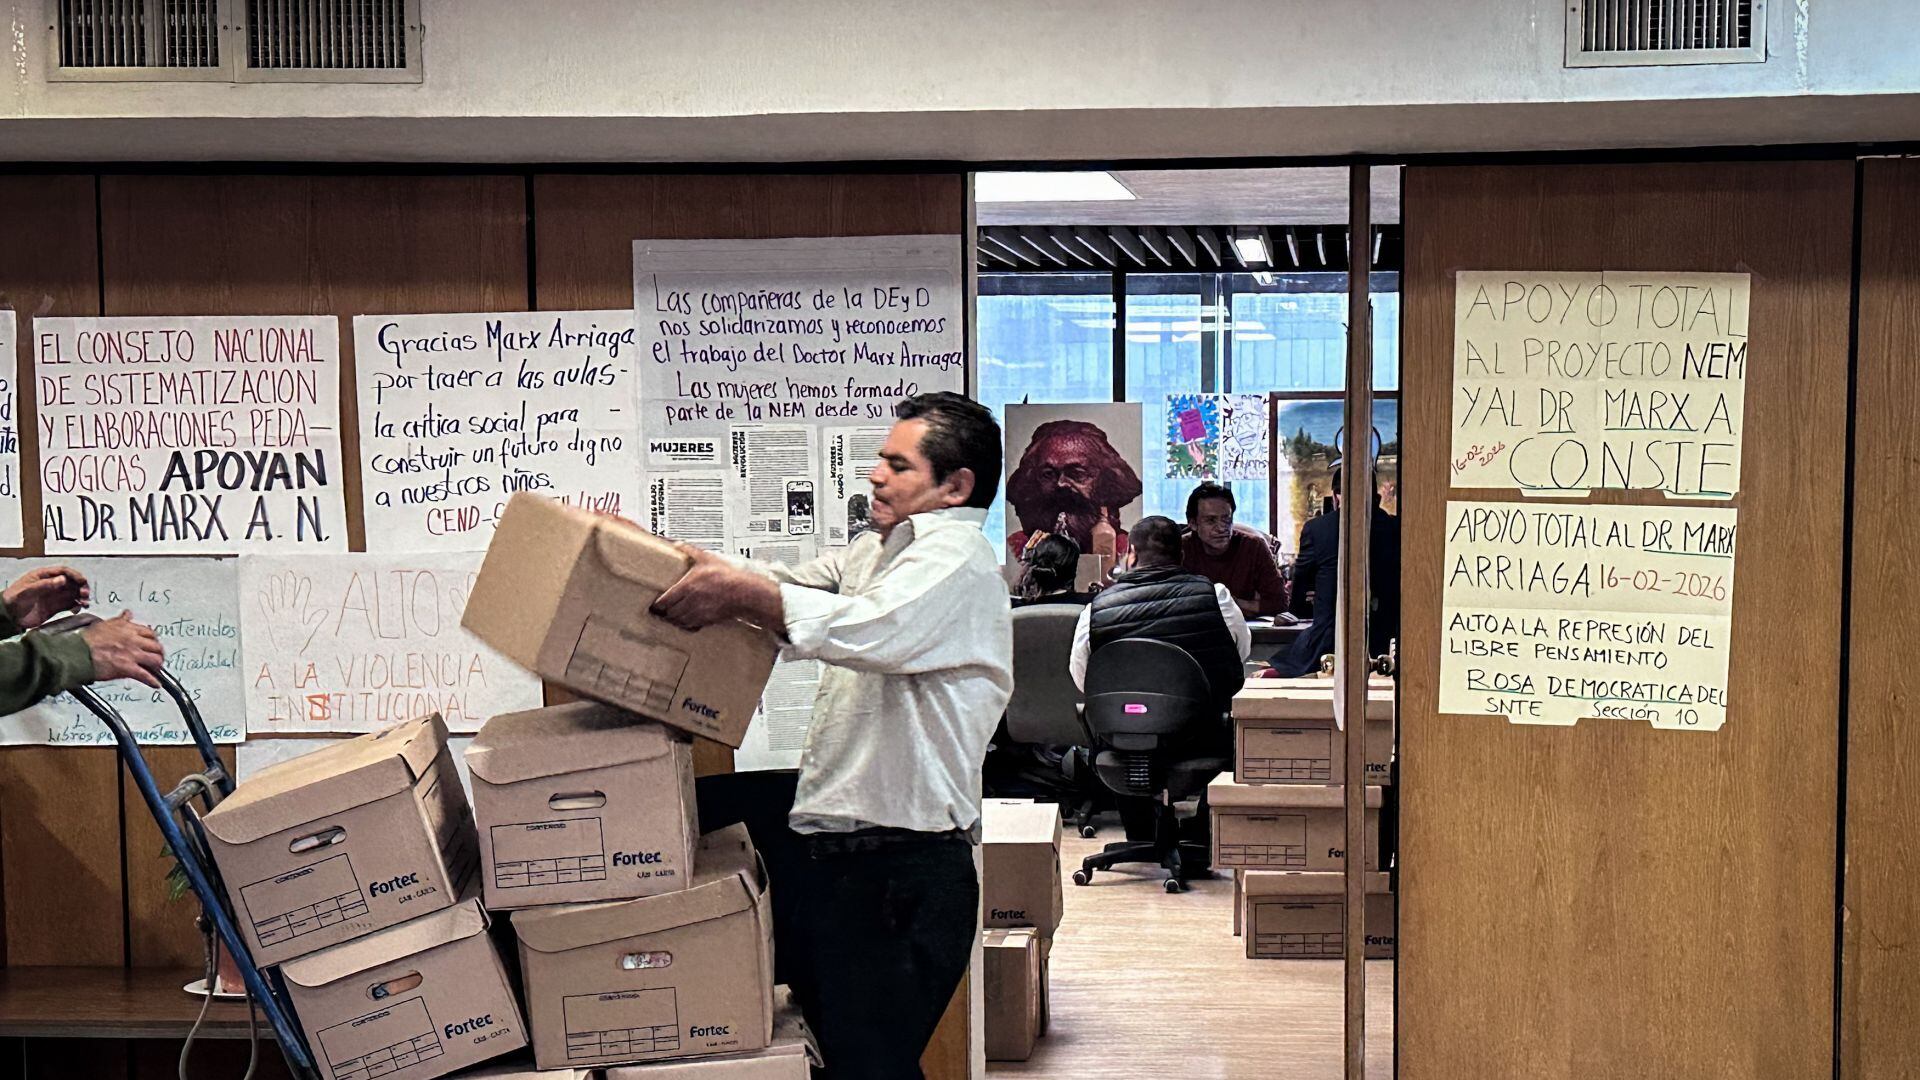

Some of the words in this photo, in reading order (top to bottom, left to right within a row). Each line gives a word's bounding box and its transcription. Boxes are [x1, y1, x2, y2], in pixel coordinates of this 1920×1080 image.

[653, 273, 691, 315] Las
[701, 288, 801, 317] compañeras
[812, 288, 835, 309] de
[843, 287, 863, 309] la
[1466, 281, 1618, 327] APOYO
[1628, 284, 1747, 337] TOTAL
[41, 333, 71, 364] EL
[77, 330, 195, 364] CONSEJO
[214, 328, 325, 363] NACIONAL
[377, 322, 478, 369] Gracias
[485, 320, 542, 362] Marx
[548, 318, 636, 358] Arriaga
[660, 319, 691, 337] nos
[699, 313, 824, 337] solidarizamos
[831, 318, 841, 343] y
[846, 317, 946, 336] reconocemos
[652, 340, 671, 364] el
[680, 339, 747, 372] trabajo
[753, 342, 784, 364] del
[793, 343, 846, 365] Doctor
[854, 341, 895, 366] Marx
[1466, 339, 1505, 375] AL
[1523, 338, 1672, 379] PROYECTO
[1682, 341, 1747, 380] NEM
[42, 375, 71, 406] DE
[84, 369, 317, 405] SISTEMATIZACION
[373, 372, 418, 405] por
[421, 364, 483, 391] traer
[485, 371, 503, 388] a
[517, 358, 545, 390] las
[677, 370, 712, 400] Las
[717, 380, 777, 400] mujeres
[785, 377, 838, 399] hemos
[844, 377, 918, 399] formado
[375, 411, 395, 438] la
[469, 400, 526, 434] social
[537, 408, 579, 443] para
[665, 402, 709, 426] parte
[715, 400, 734, 420] de
[748, 401, 762, 422] la
[769, 402, 806, 419] NEM
[815, 396, 858, 418] desde
[866, 402, 882, 419] su
[1540, 388, 1574, 432] DR
[1605, 388, 1692, 431] MARX
[41, 413, 55, 449] Y
[67, 410, 237, 450] ELABORACIONES
[651, 442, 714, 453] MUJERES
[372, 445, 466, 475] construir
[472, 447, 494, 463] un
[499, 432, 559, 469] futuro
[567, 428, 622, 466] digno
[43, 454, 147, 493] GOGICAS
[158, 448, 328, 492] APOYAN
[375, 491, 391, 507] a
[401, 467, 491, 505] nuestros
[44, 504, 77, 542] AL
[129, 493, 229, 542] MARX
[1450, 508, 1528, 544] APOYO
[1532, 512, 1600, 548] TOTAL
[1606, 521, 1636, 549] AL
[1684, 521, 1736, 554] MARX
[139, 580, 172, 604] las
[1600, 563, 1726, 601] 16-02-2026
[335, 570, 440, 640] ALTO
[1558, 618, 1665, 645] REPRESIÓN
[1678, 626, 1714, 649] DEL
[254, 662, 275, 689] A
[293, 662, 320, 689] LA
[336, 653, 488, 689] VIOLENCIA
[1449, 639, 1519, 658] LIBRE
[1535, 643, 1669, 670] PENSAMIENTO
[1467, 669, 1535, 690] ROSA
[1547, 675, 1693, 702] DEMOCRATICA
[1697, 684, 1728, 708] DEL
[267, 692, 480, 722] INSTITUCIONAL
[681, 698, 720, 719] Fortec
[1485, 697, 1543, 717] SNTE
[1592, 701, 1660, 722] Sección
[1674, 709, 1699, 726] 10
[613, 851, 662, 867] Fortec
[369, 872, 419, 898] Fortec
[990, 908, 1026, 920] Fortec
[444, 1013, 494, 1039] Fortec
[690, 1025, 730, 1038] Fortec
